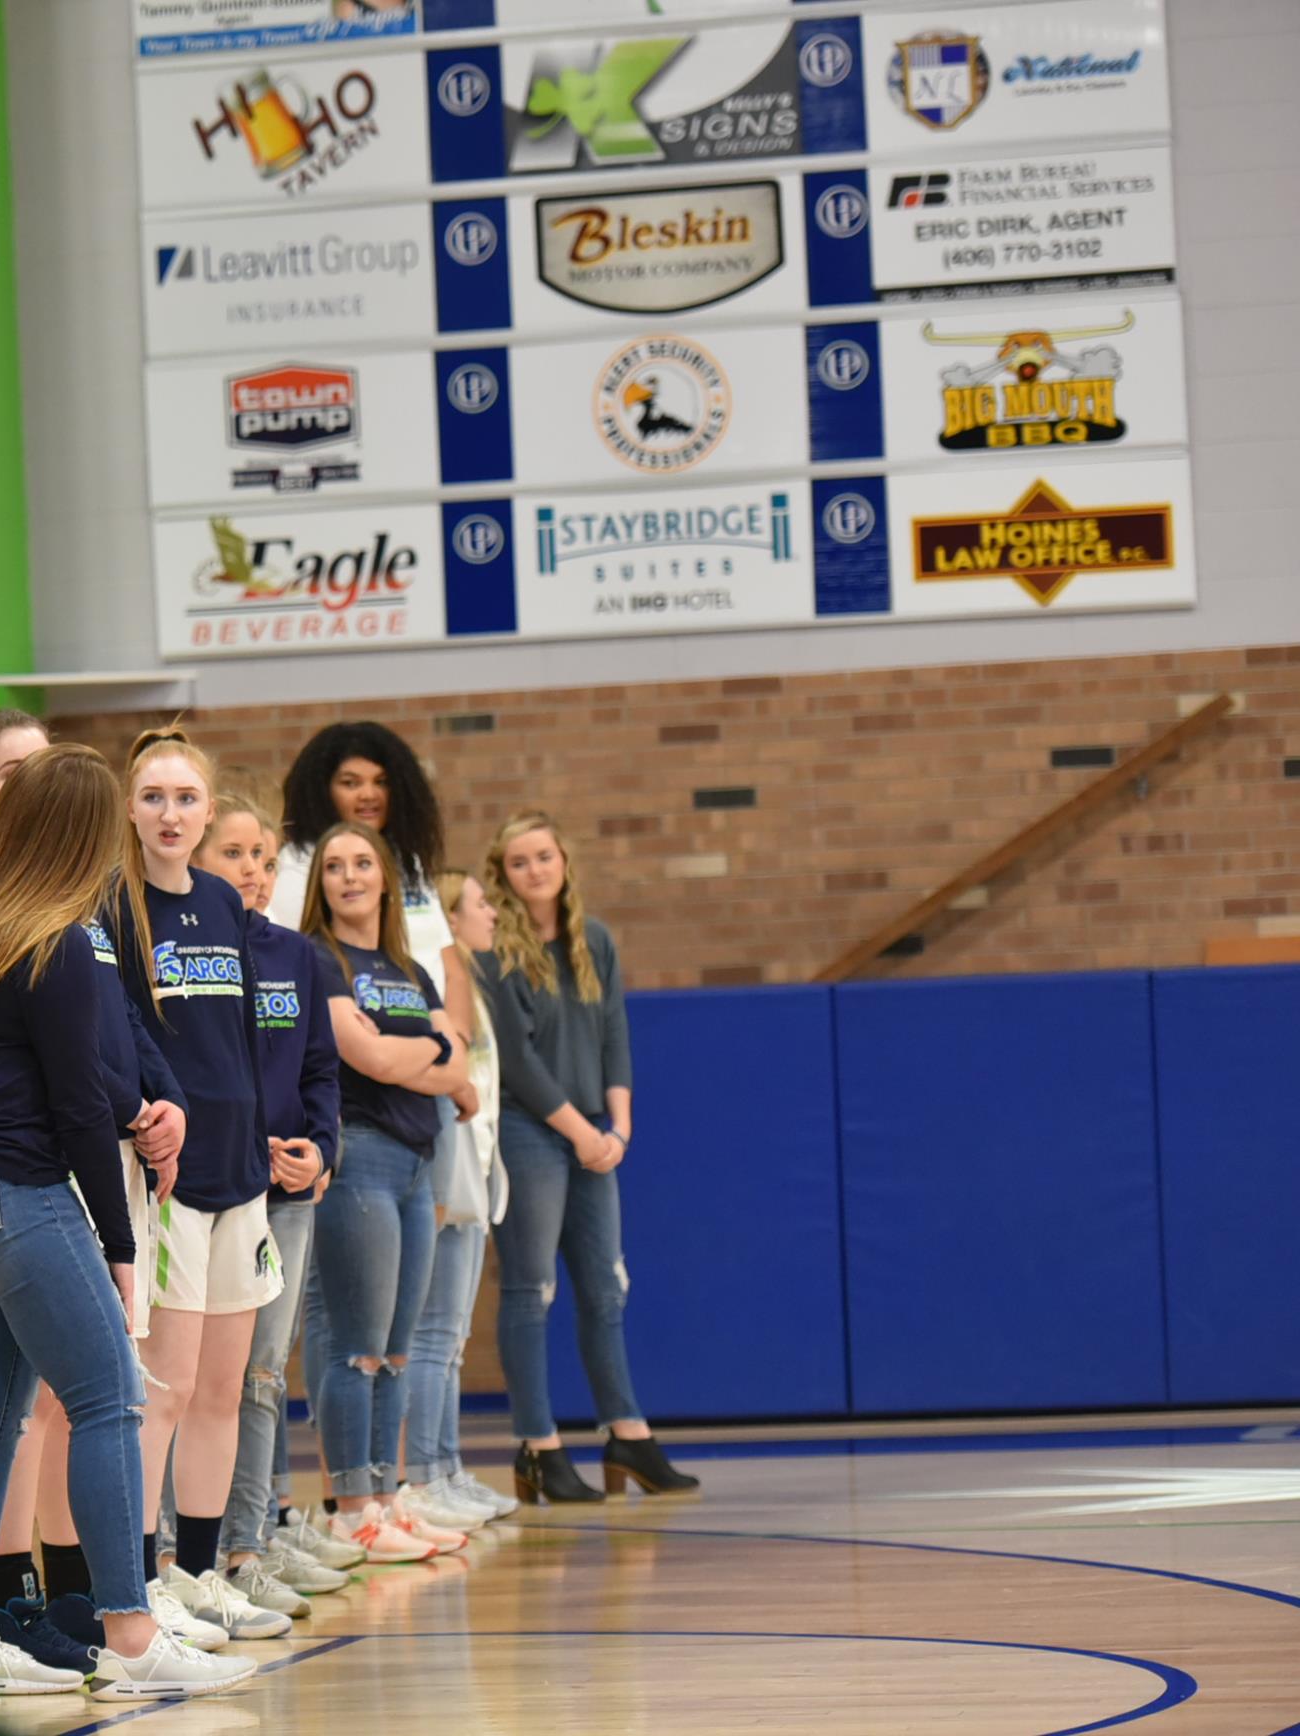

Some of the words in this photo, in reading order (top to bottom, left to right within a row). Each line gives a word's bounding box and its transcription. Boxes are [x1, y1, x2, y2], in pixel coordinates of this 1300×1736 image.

[659, 108, 798, 143] SIGNS
[279, 118, 380, 196] TAVERN
[550, 205, 753, 267] Bleskin
[914, 220, 971, 242] ERIC
[1046, 206, 1127, 231] AGENT
[203, 242, 314, 284] Leavitt
[317, 234, 420, 277] Group
[651, 256, 758, 278] COMPANY
[225, 296, 365, 324] INSURANCE
[237, 383, 349, 411] town
[943, 385, 997, 437] BIG
[1003, 378, 1117, 428] MOUTH
[239, 406, 350, 438] pump
[987, 420, 1088, 449] BBQ
[560, 504, 763, 546] STAYBRIDGE
[979, 519, 1101, 548] HOINES
[238, 532, 419, 612] Eagle
[595, 557, 734, 583] SUITES
[934, 546, 1002, 573] LAW
[674, 588, 735, 611] HOTEL
[191, 610, 409, 647] BEVERAGE
